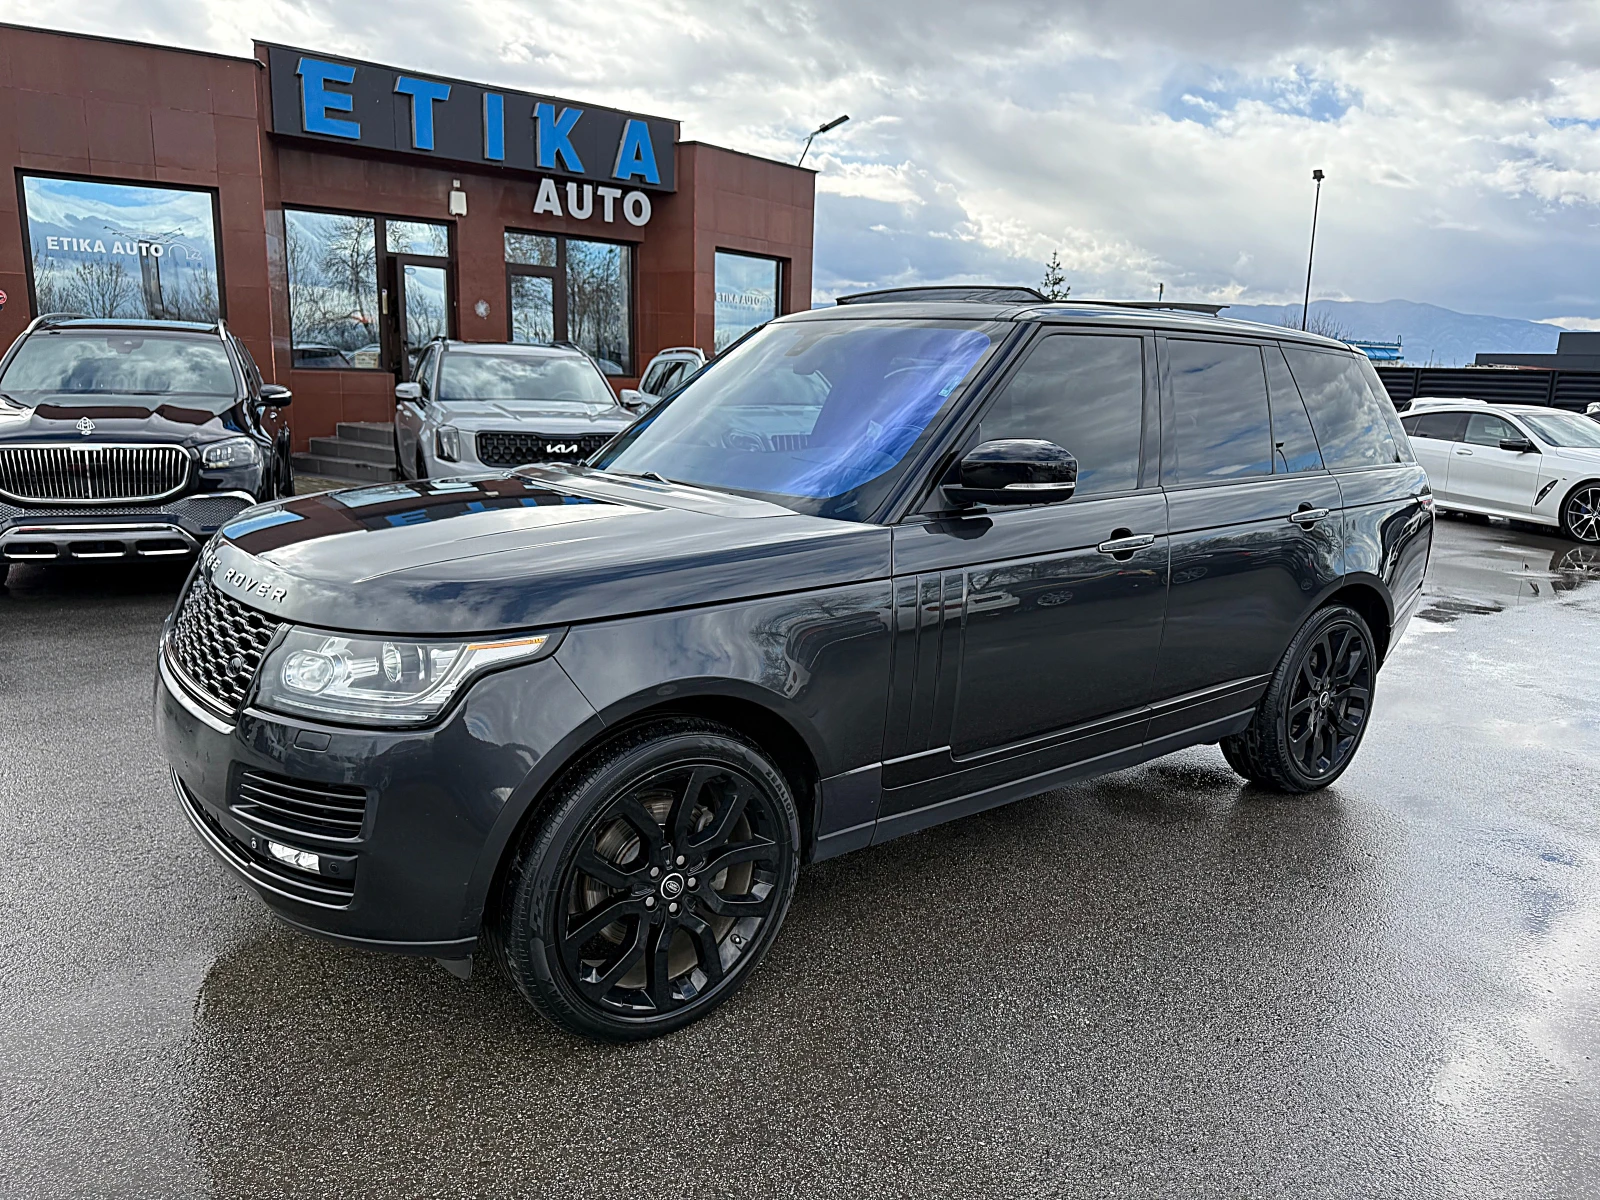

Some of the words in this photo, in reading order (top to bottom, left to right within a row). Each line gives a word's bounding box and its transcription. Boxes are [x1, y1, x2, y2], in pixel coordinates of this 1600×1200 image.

[296, 57, 661, 185] ETIKA
[533, 177, 652, 227] AUTO
[47, 236, 107, 254] ETIKA
[112, 241, 164, 257] AUTO
[546, 443, 578, 453] KIA
[224, 567, 287, 603] ROVER
[765, 767, 794, 821] ZEALION
